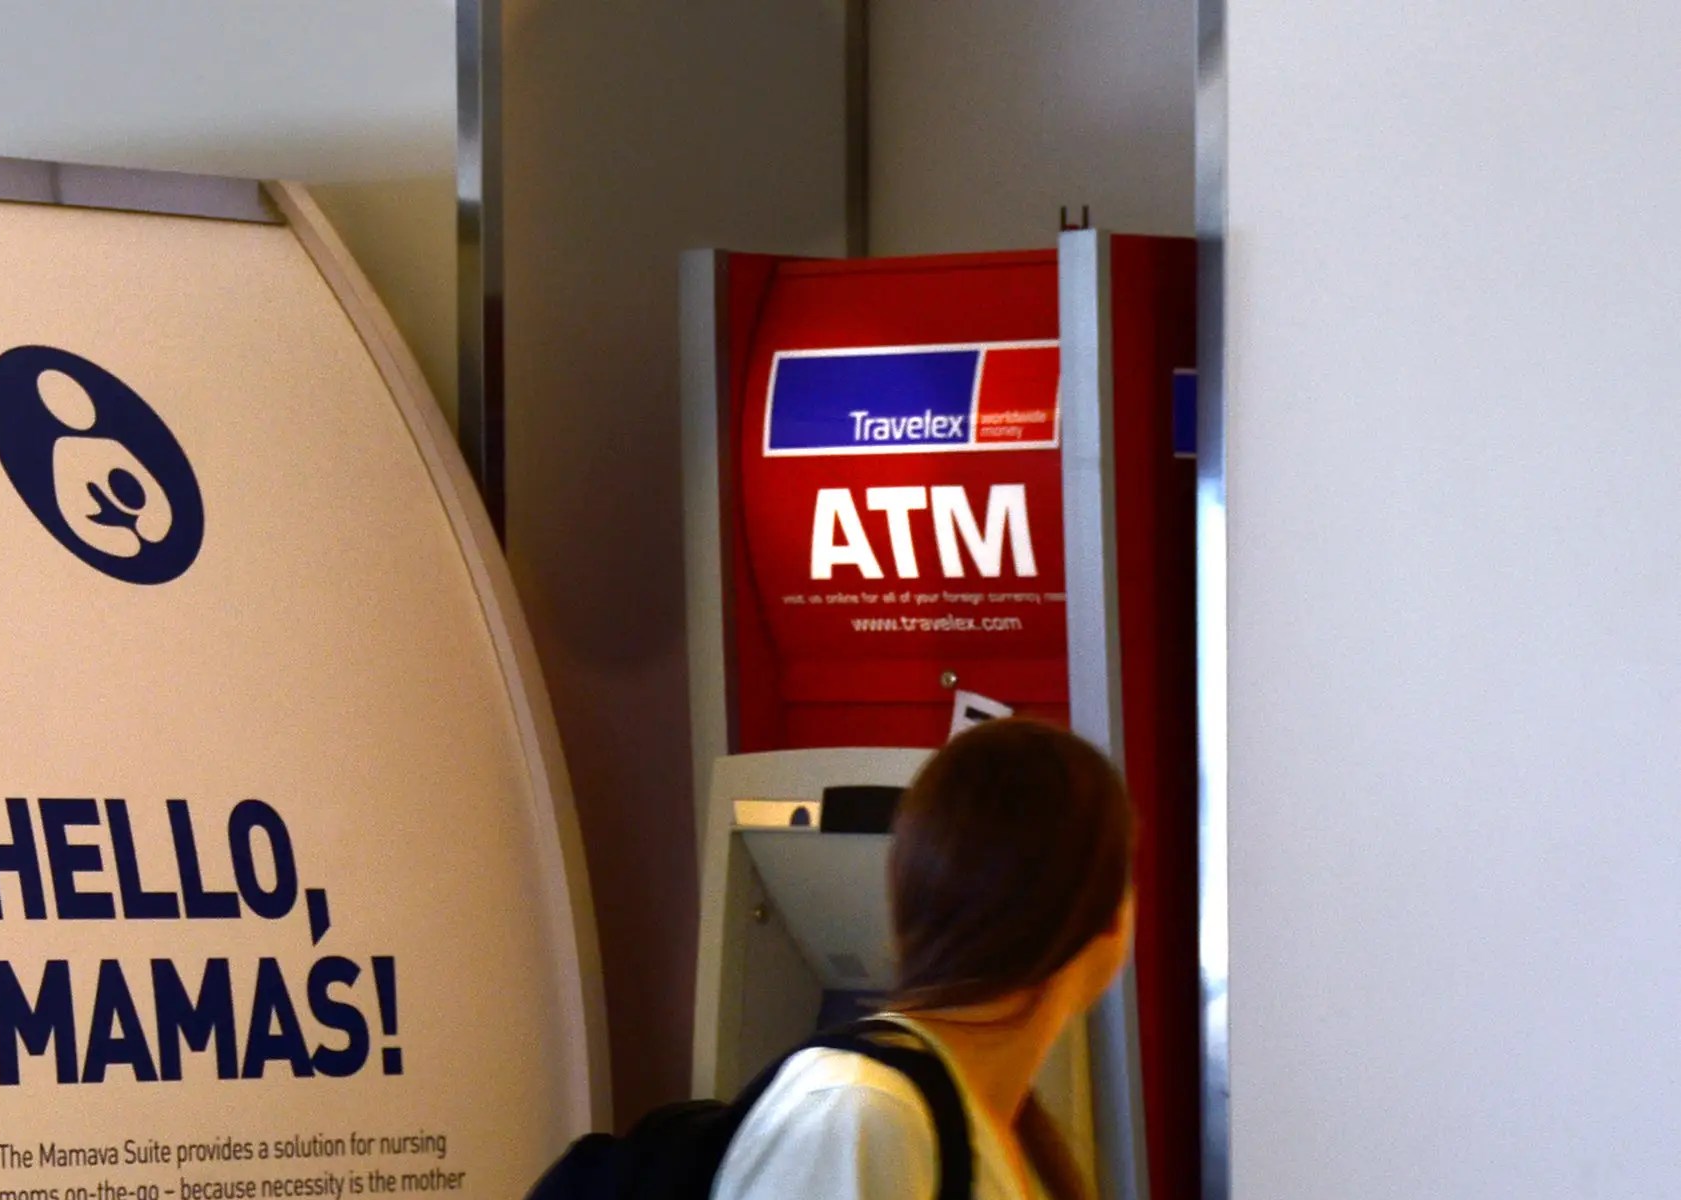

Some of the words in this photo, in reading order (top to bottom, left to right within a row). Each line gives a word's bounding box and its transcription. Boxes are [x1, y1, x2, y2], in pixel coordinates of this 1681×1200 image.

[849, 409, 964, 441] Travelex
[810, 483, 1039, 580] ATM
[851, 613, 1023, 632] www.travelex.com
[39, 1140, 119, 1169] Mamava
[124, 1139, 171, 1165] Suite
[177, 1136, 254, 1169] provides
[258, 1141, 269, 1160] a
[274, 1133, 346, 1159] solution
[350, 1131, 376, 1156] for
[380, 1129, 447, 1159] nursing
[180, 1176, 256, 1200] because
[261, 1171, 345, 1200] necessity
[349, 1169, 364, 1194] is
[368, 1169, 396, 1193] the
[401, 1167, 466, 1192] mother
